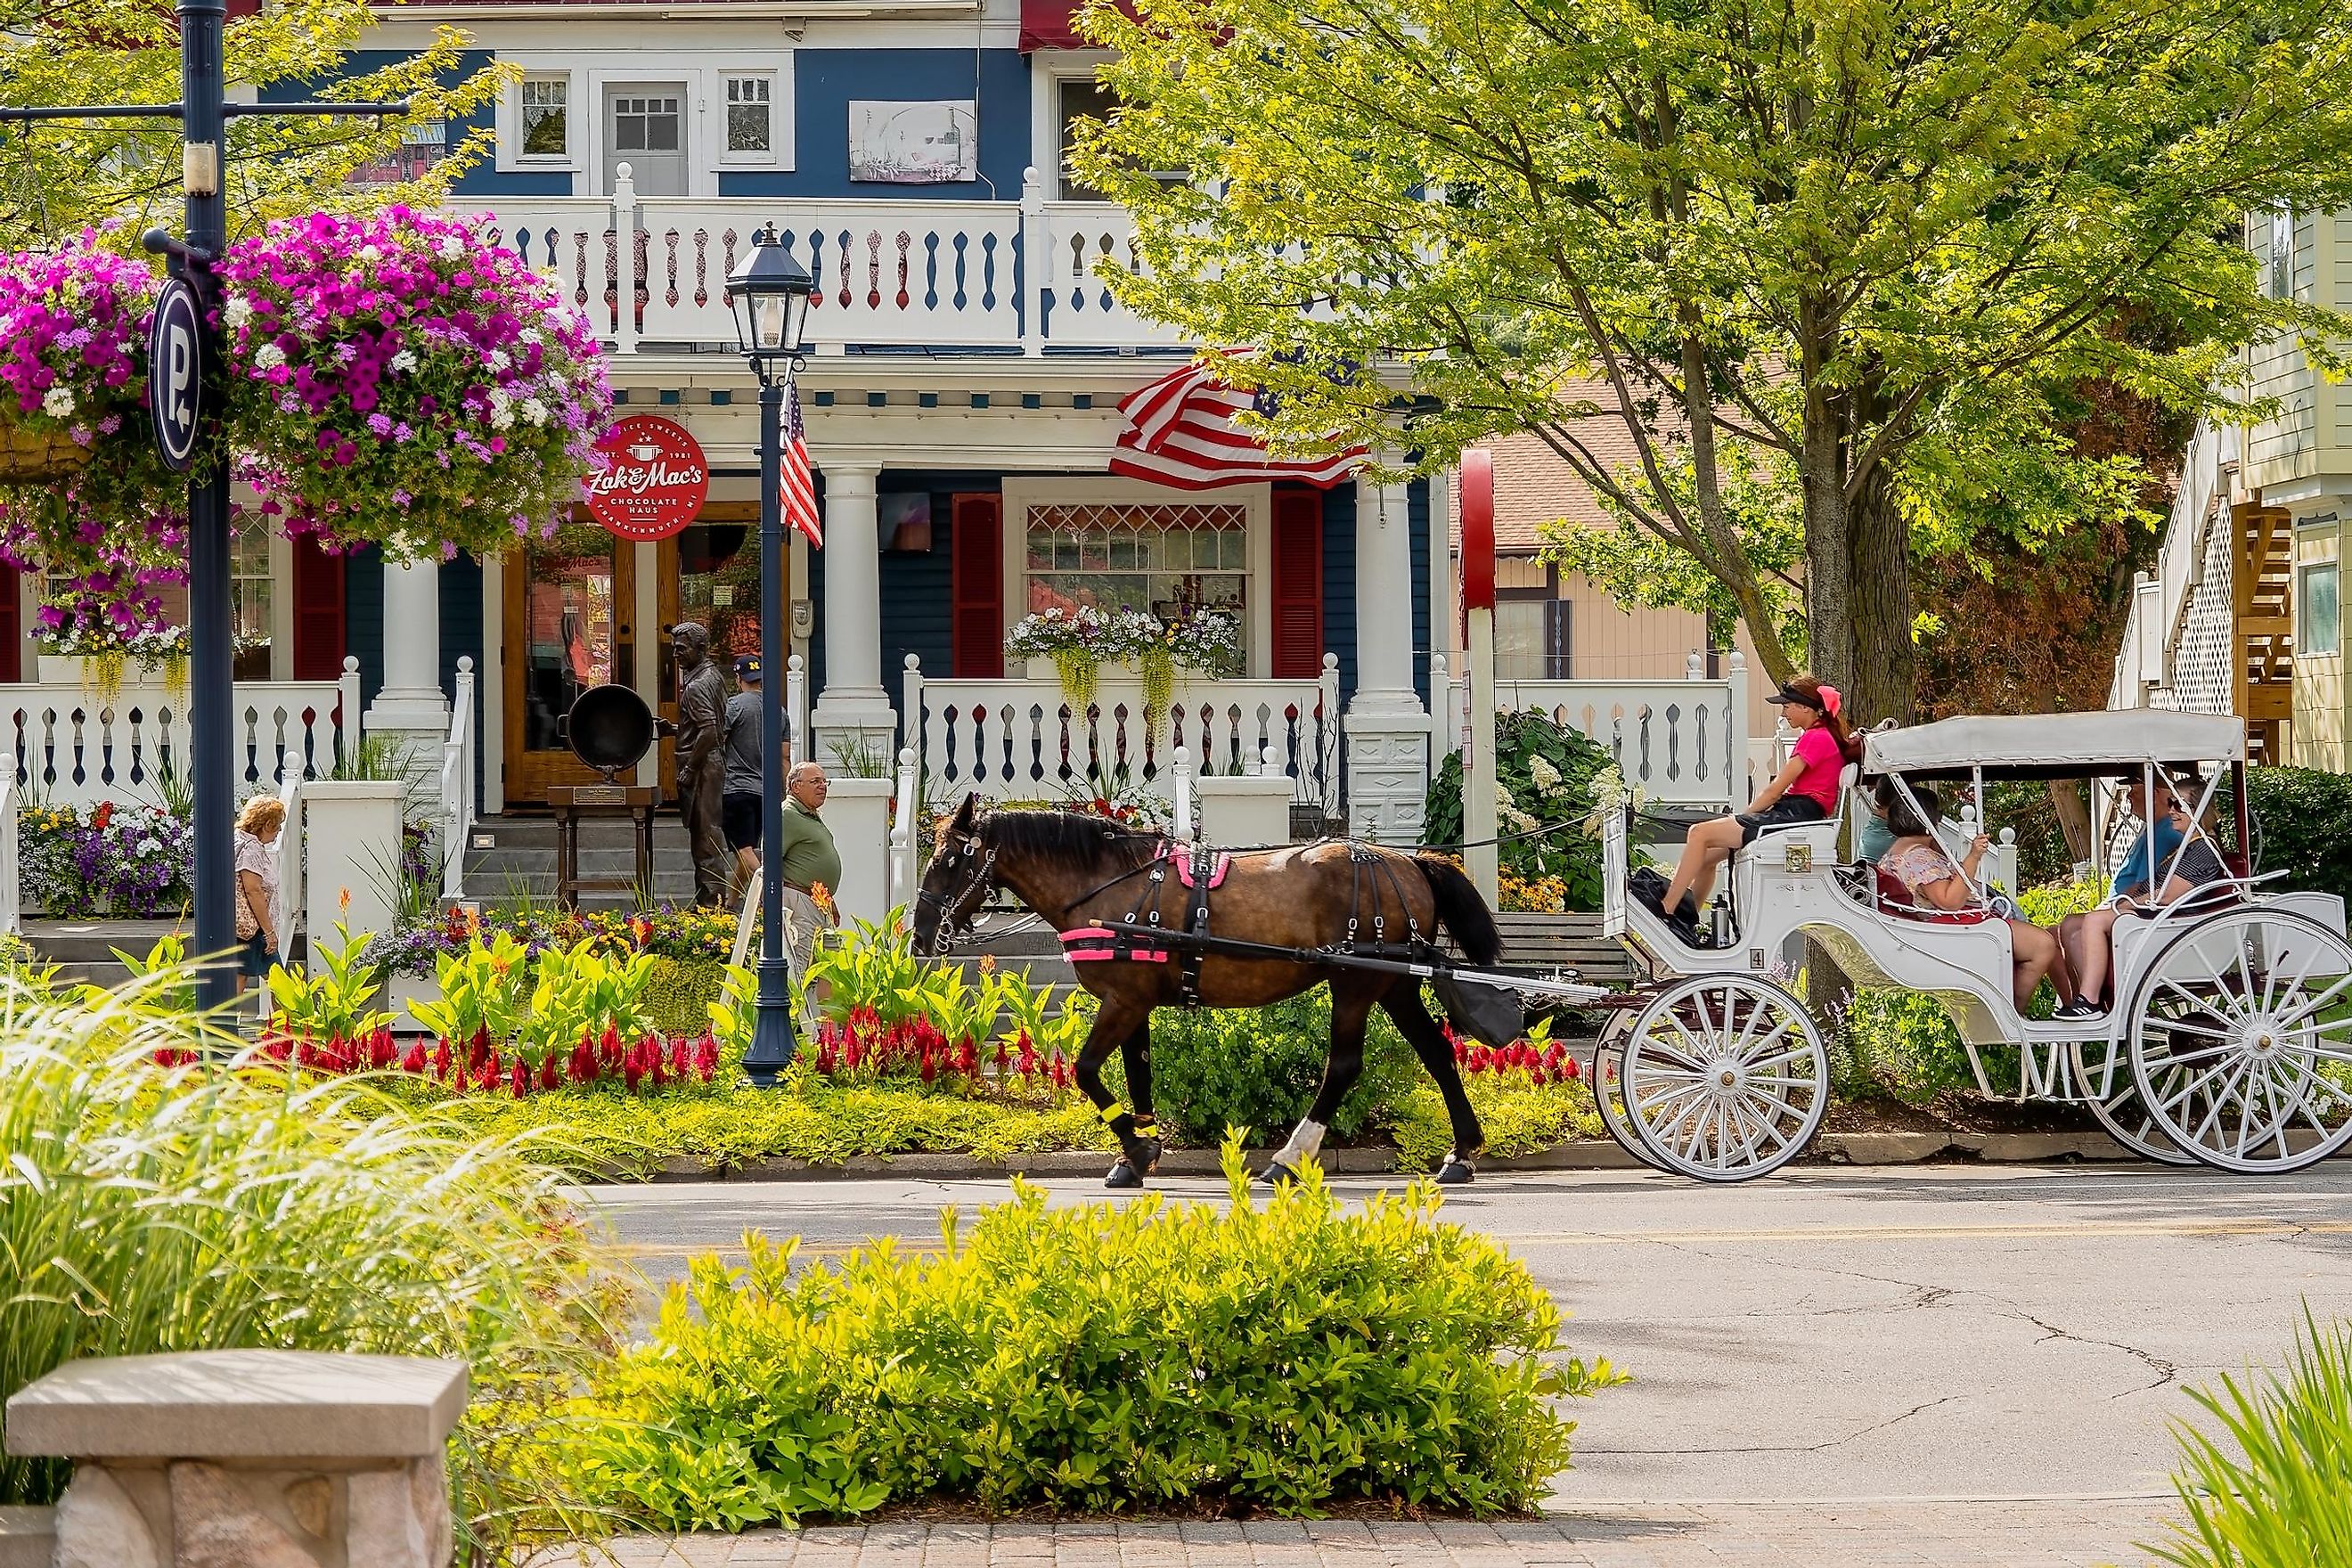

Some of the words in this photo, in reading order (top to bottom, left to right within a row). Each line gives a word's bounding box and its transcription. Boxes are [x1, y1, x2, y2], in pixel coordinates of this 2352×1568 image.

[168, 323, 190, 421] P
[649, 423, 688, 447] SWEETS
[686, 494, 697, 508] MI
[1752, 951, 1761, 966] 4
